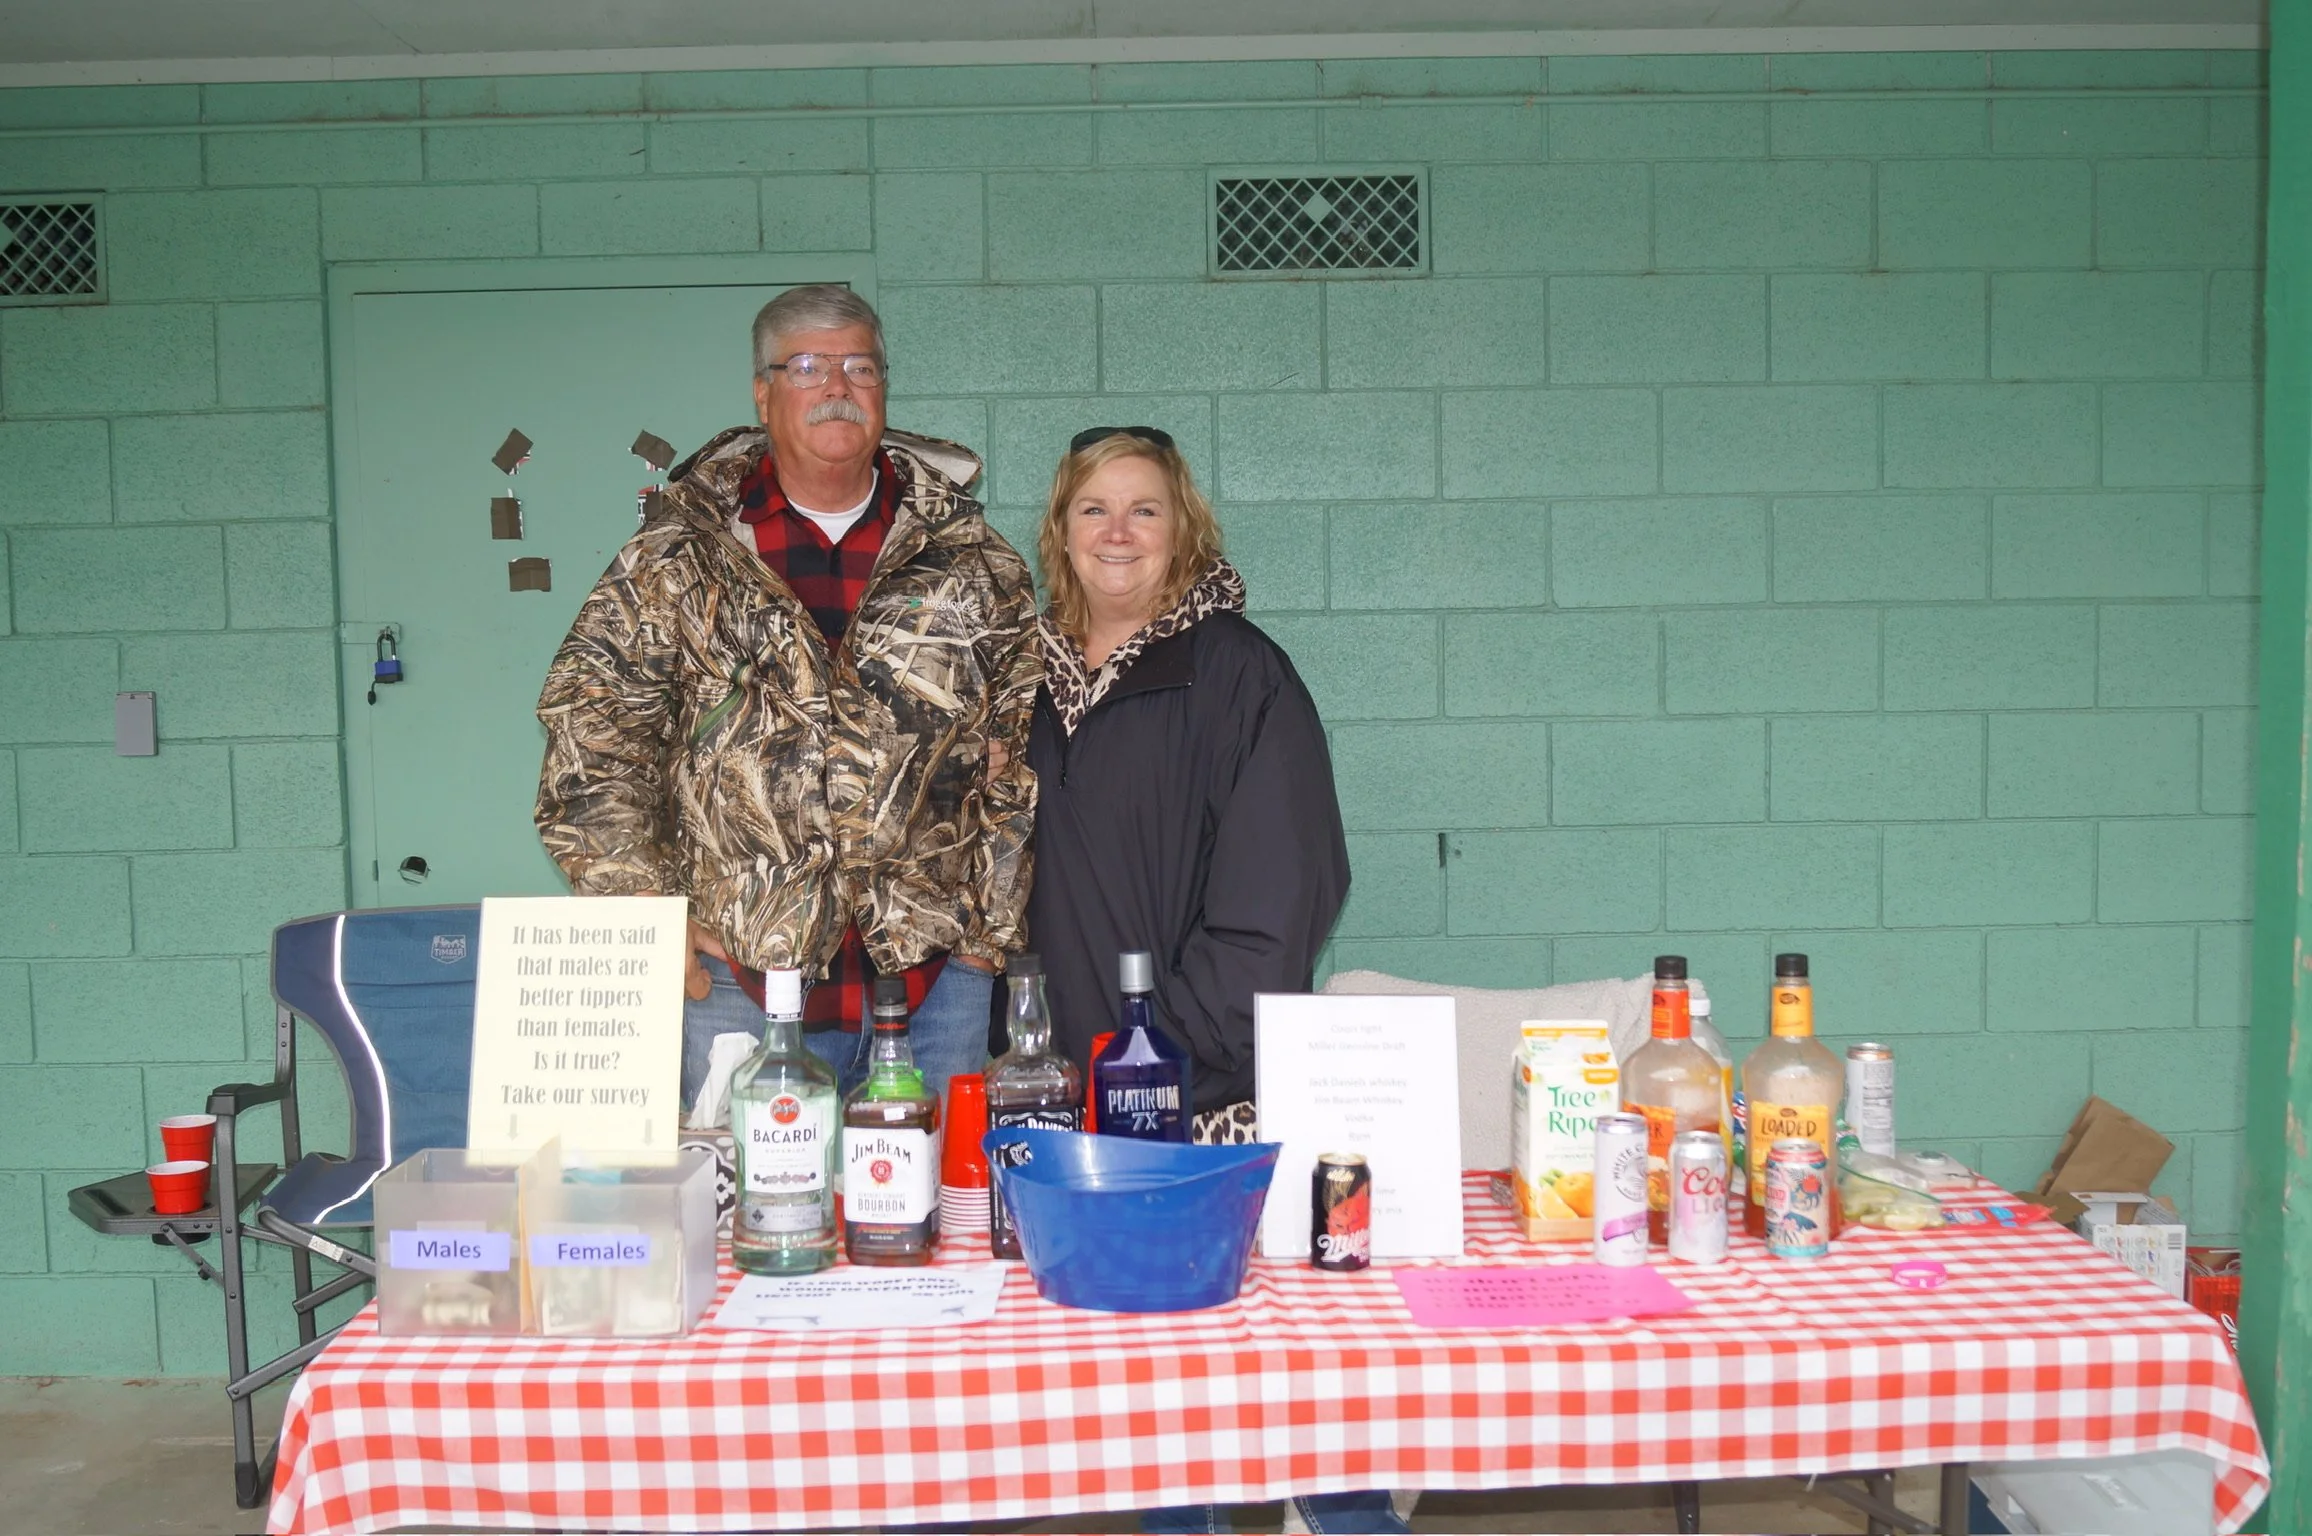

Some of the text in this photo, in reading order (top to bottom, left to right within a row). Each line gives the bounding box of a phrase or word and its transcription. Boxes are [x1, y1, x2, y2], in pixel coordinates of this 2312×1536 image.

[512, 925, 657, 945] It has been said
[516, 955, 649, 976] that males are
[519, 987, 643, 1009] better tippers
[516, 1017, 641, 1037] than females.
[534, 1050, 621, 1070] Is it true?
[501, 1084, 651, 1109] Take our survey
[1107, 1084, 1180, 1115] PLATINUM
[1547, 1084, 1597, 1108] Tree
[1132, 1110, 1159, 1132] 7X
[1761, 1117, 1818, 1137] LOADED
[857, 1198, 906, 1213] BOURBON
[416, 1240, 482, 1259] Males
[557, 1241, 646, 1261] Females
